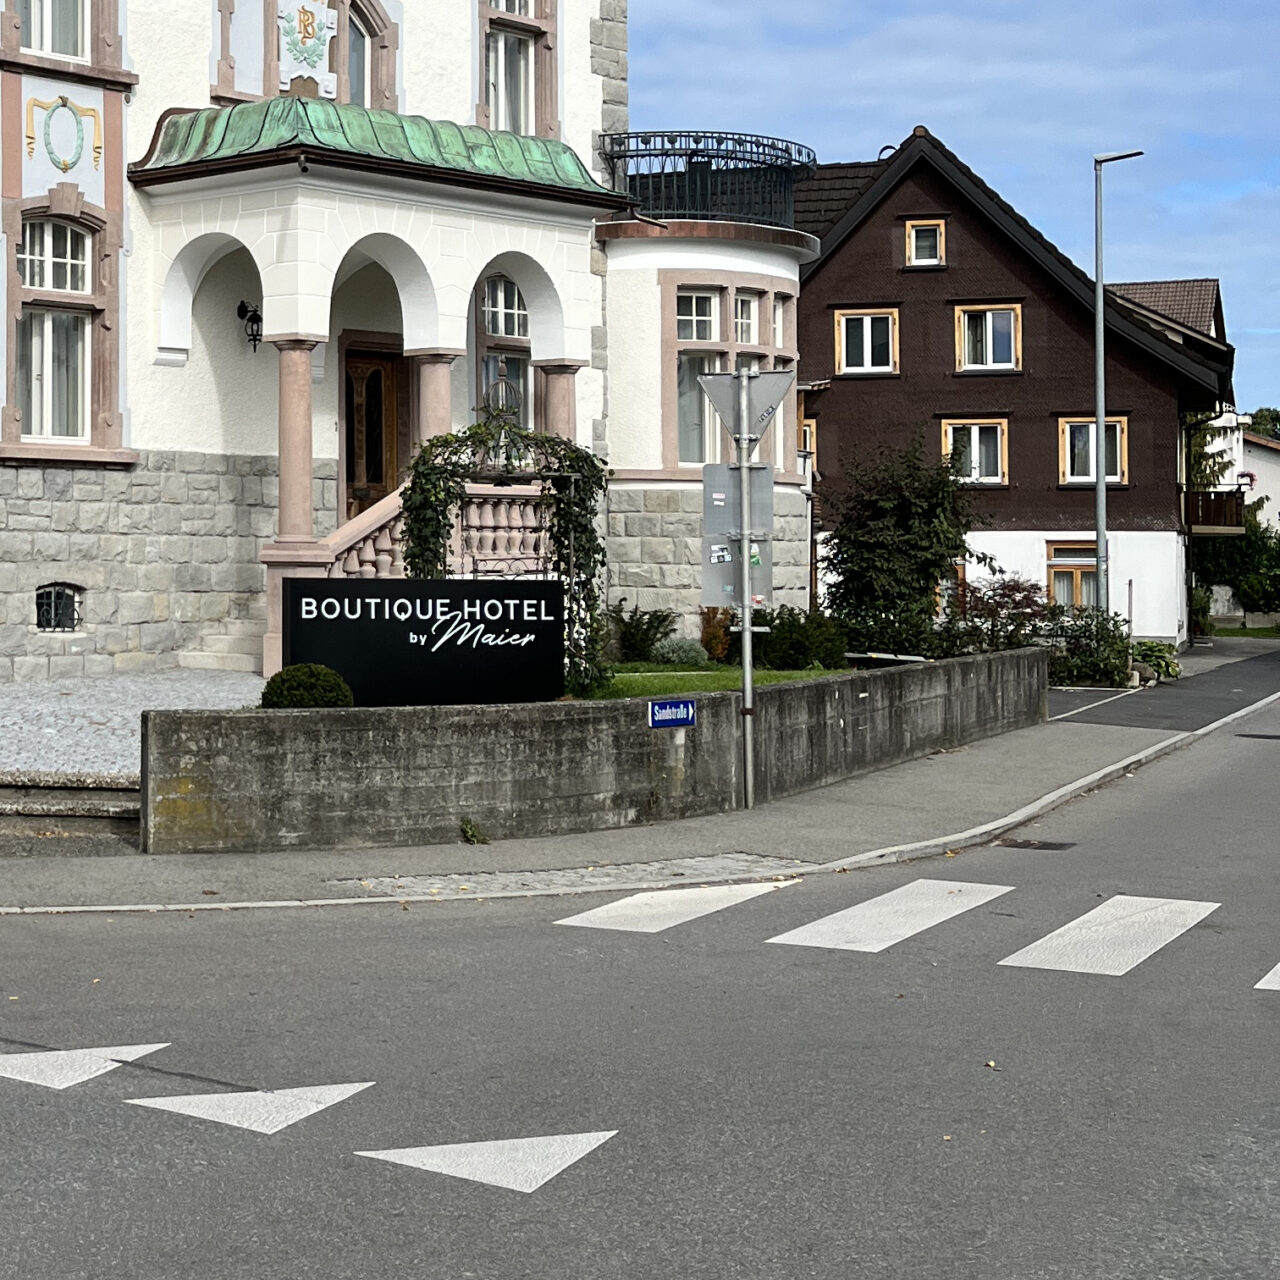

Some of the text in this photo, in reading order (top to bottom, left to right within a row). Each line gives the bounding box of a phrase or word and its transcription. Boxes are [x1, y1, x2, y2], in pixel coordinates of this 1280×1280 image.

[301, 598, 555, 621] BOUTIQUE HOTEL
[409, 611, 536, 652] by Maier
